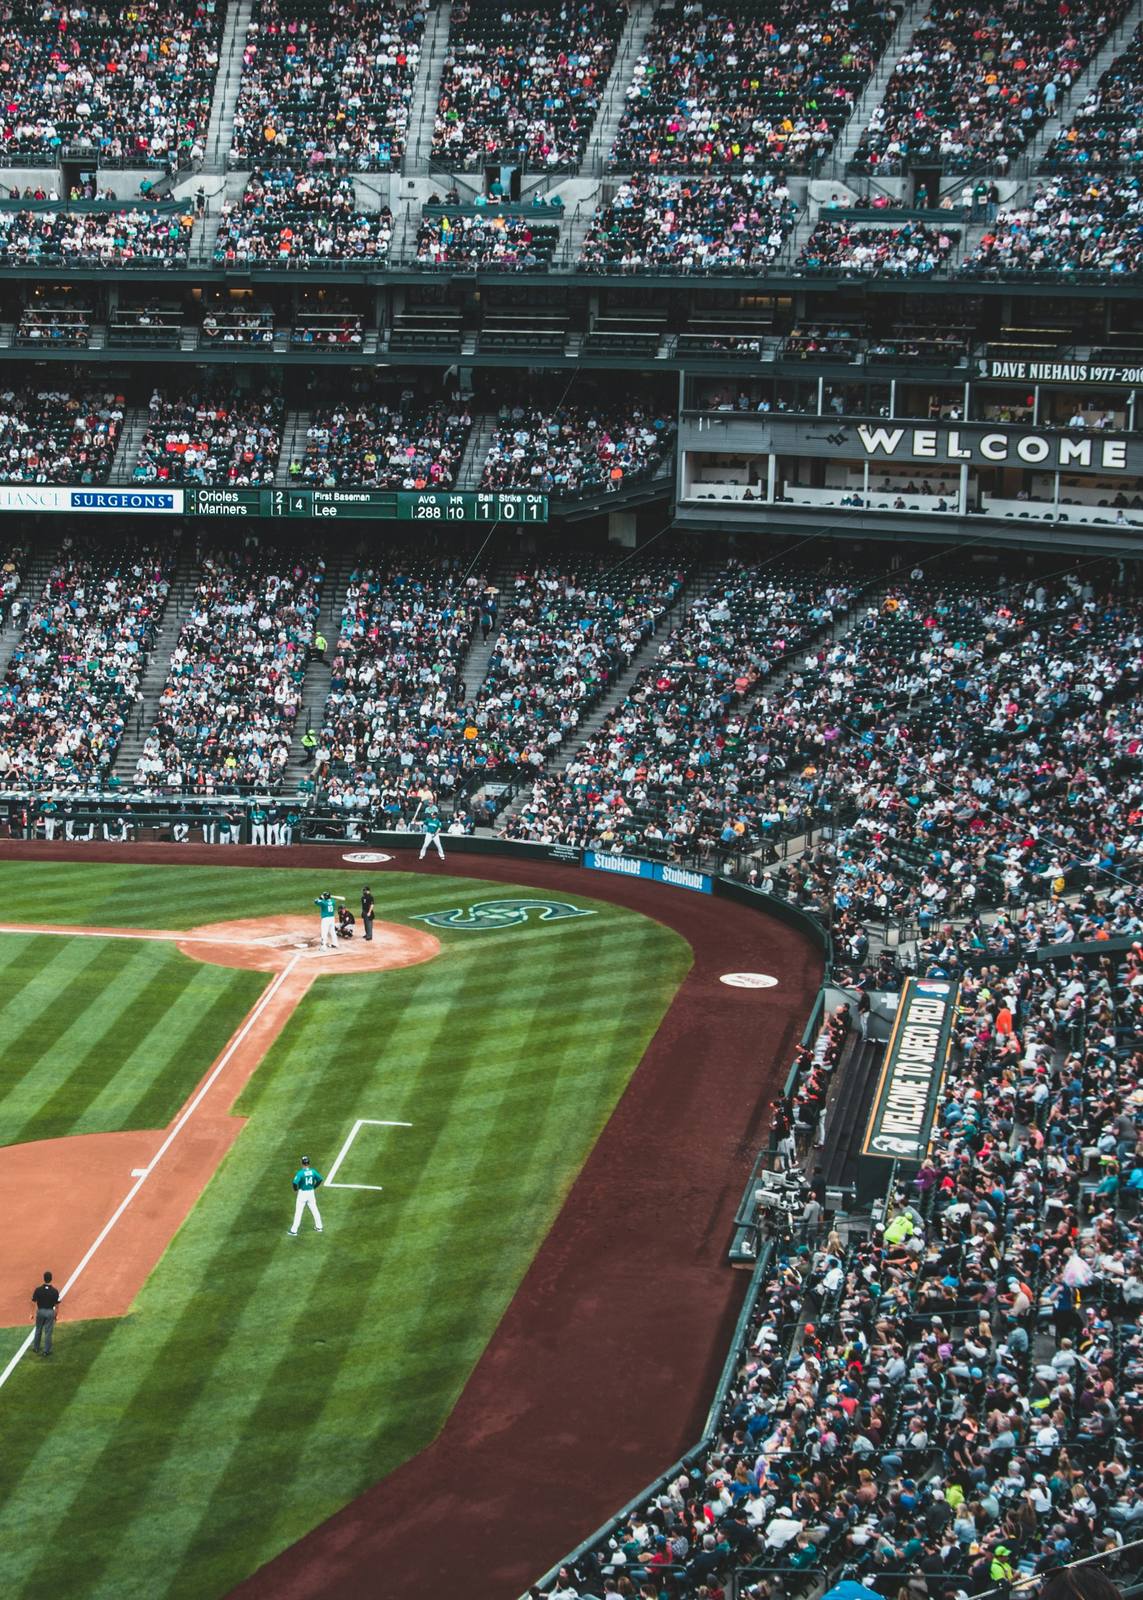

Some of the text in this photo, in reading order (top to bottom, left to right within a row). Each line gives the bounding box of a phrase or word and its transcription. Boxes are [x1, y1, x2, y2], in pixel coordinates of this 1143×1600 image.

[992, 361, 1026, 378] DAVE
[1029, 363, 1087, 381] NIEHAUS
[857, 424, 1127, 468] WELCOME
[73, 494, 166, 508] SURGEONS
[198, 490, 239, 503] Orioles
[276, 491, 283, 503] 2
[314, 492, 370, 502] First Baseman
[418, 495, 436, 504] AVG
[450, 496, 463, 505] HR
[478, 493, 493, 502] Ball
[498, 494, 521, 503] Strike
[526, 494, 542, 503] Out
[198, 503, 248, 515] Mariners
[276, 504, 282, 515] 1
[295, 499, 303, 511] 4
[314, 504, 337, 517] Lee
[481, 504, 489, 518] 1
[503, 503, 515, 519] 0
[414, 507, 441, 519] .288
[449, 508, 464, 519] 10
[530, 505, 538, 519] 1
[594, 854, 640, 874] StubHub!
[662, 866, 703, 889] StubHub!
[880, 998, 946, 1134] WELCOME TO SAFECO FIELD
